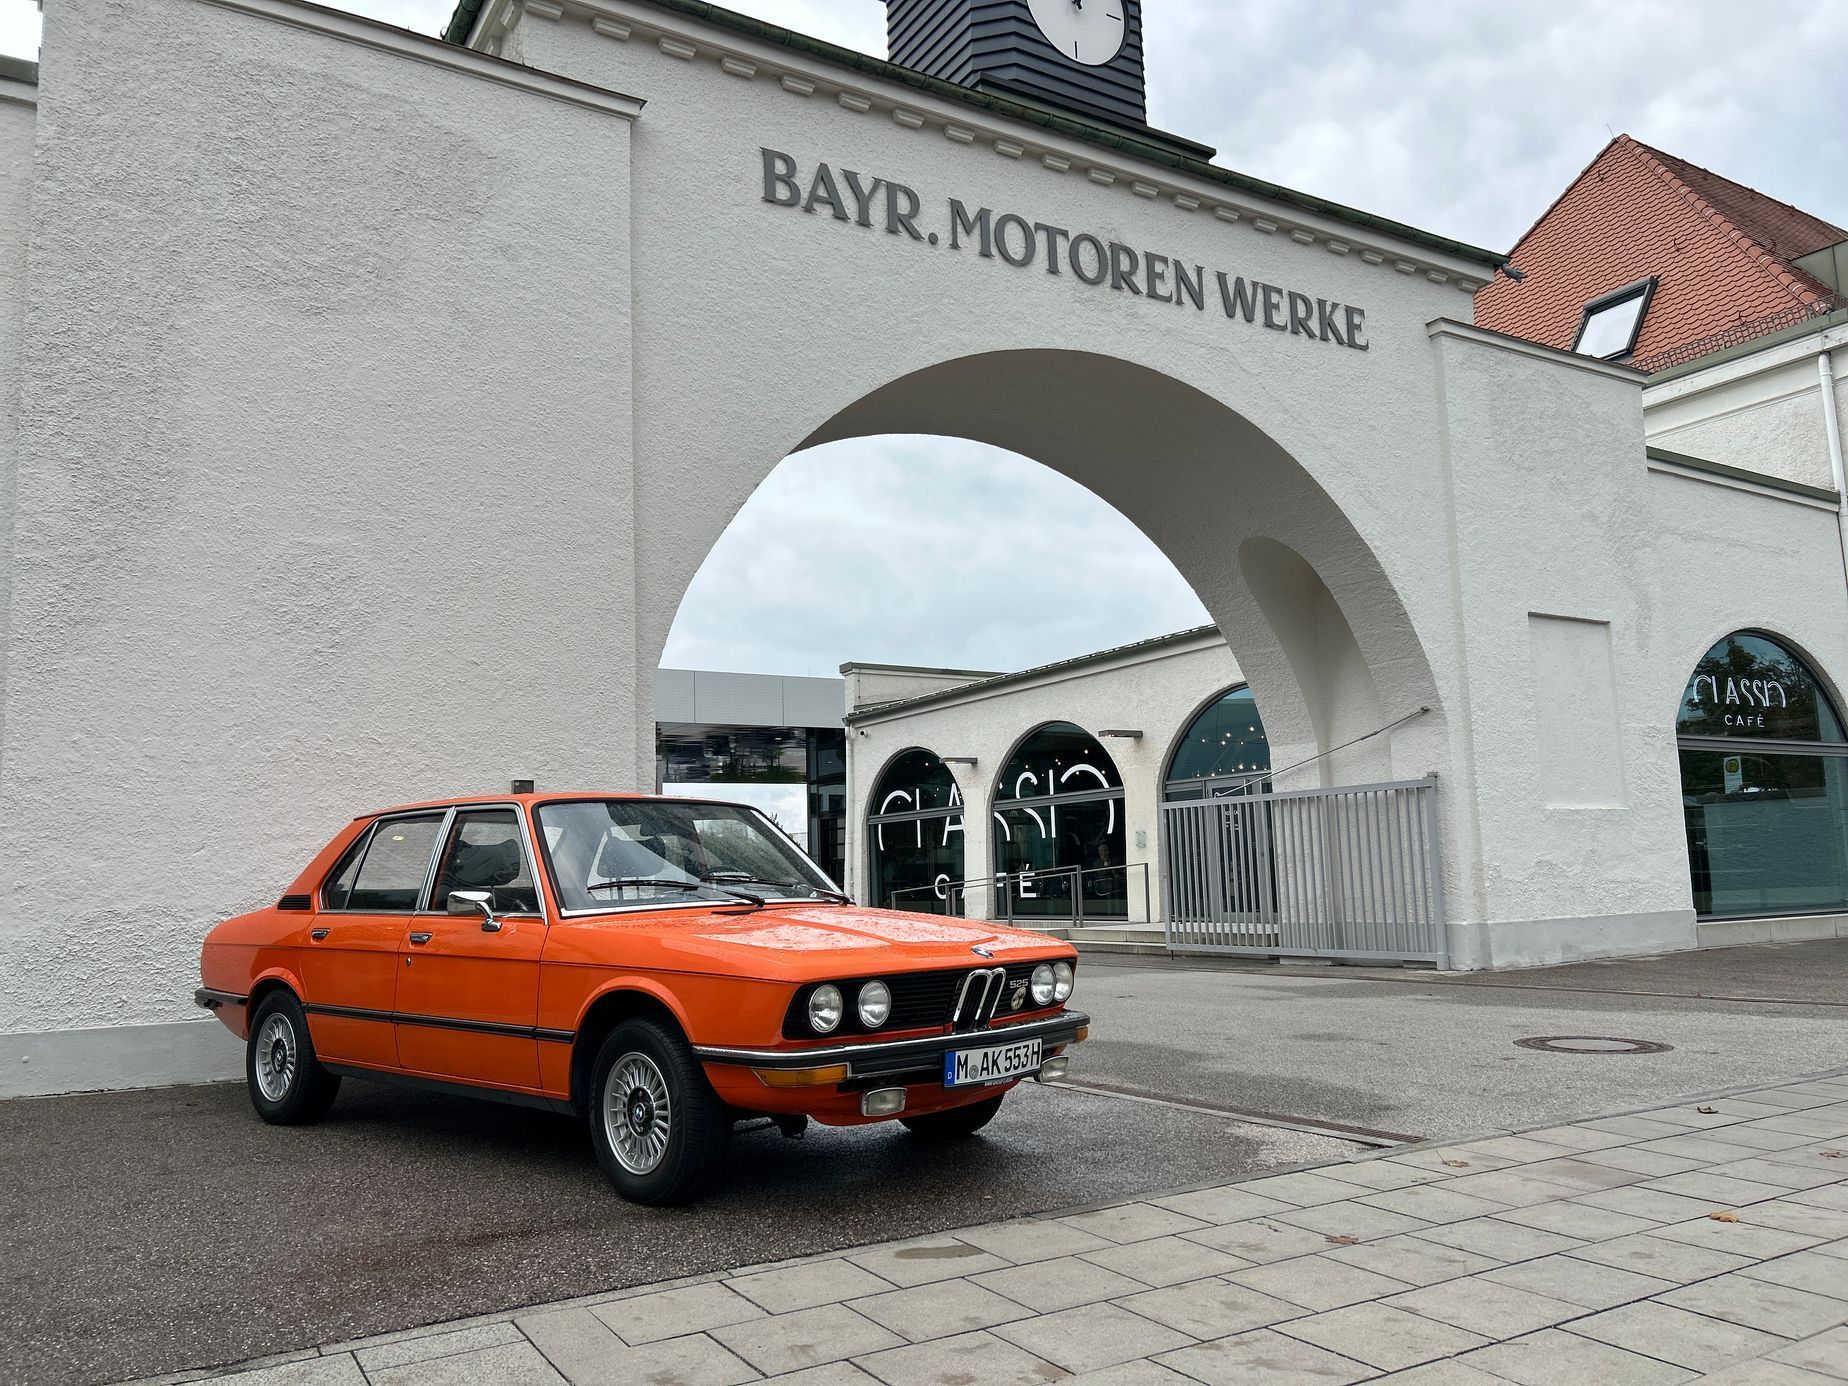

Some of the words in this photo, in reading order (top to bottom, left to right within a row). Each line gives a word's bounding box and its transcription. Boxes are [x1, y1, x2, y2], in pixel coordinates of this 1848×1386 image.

[760, 147, 938, 245] BAYR.
[948, 197, 1206, 310] MOTOREN
[1215, 271, 1369, 351] WERKE
[1724, 713, 1765, 728] CAFÉ
[1009, 978, 1029, 989] 525
